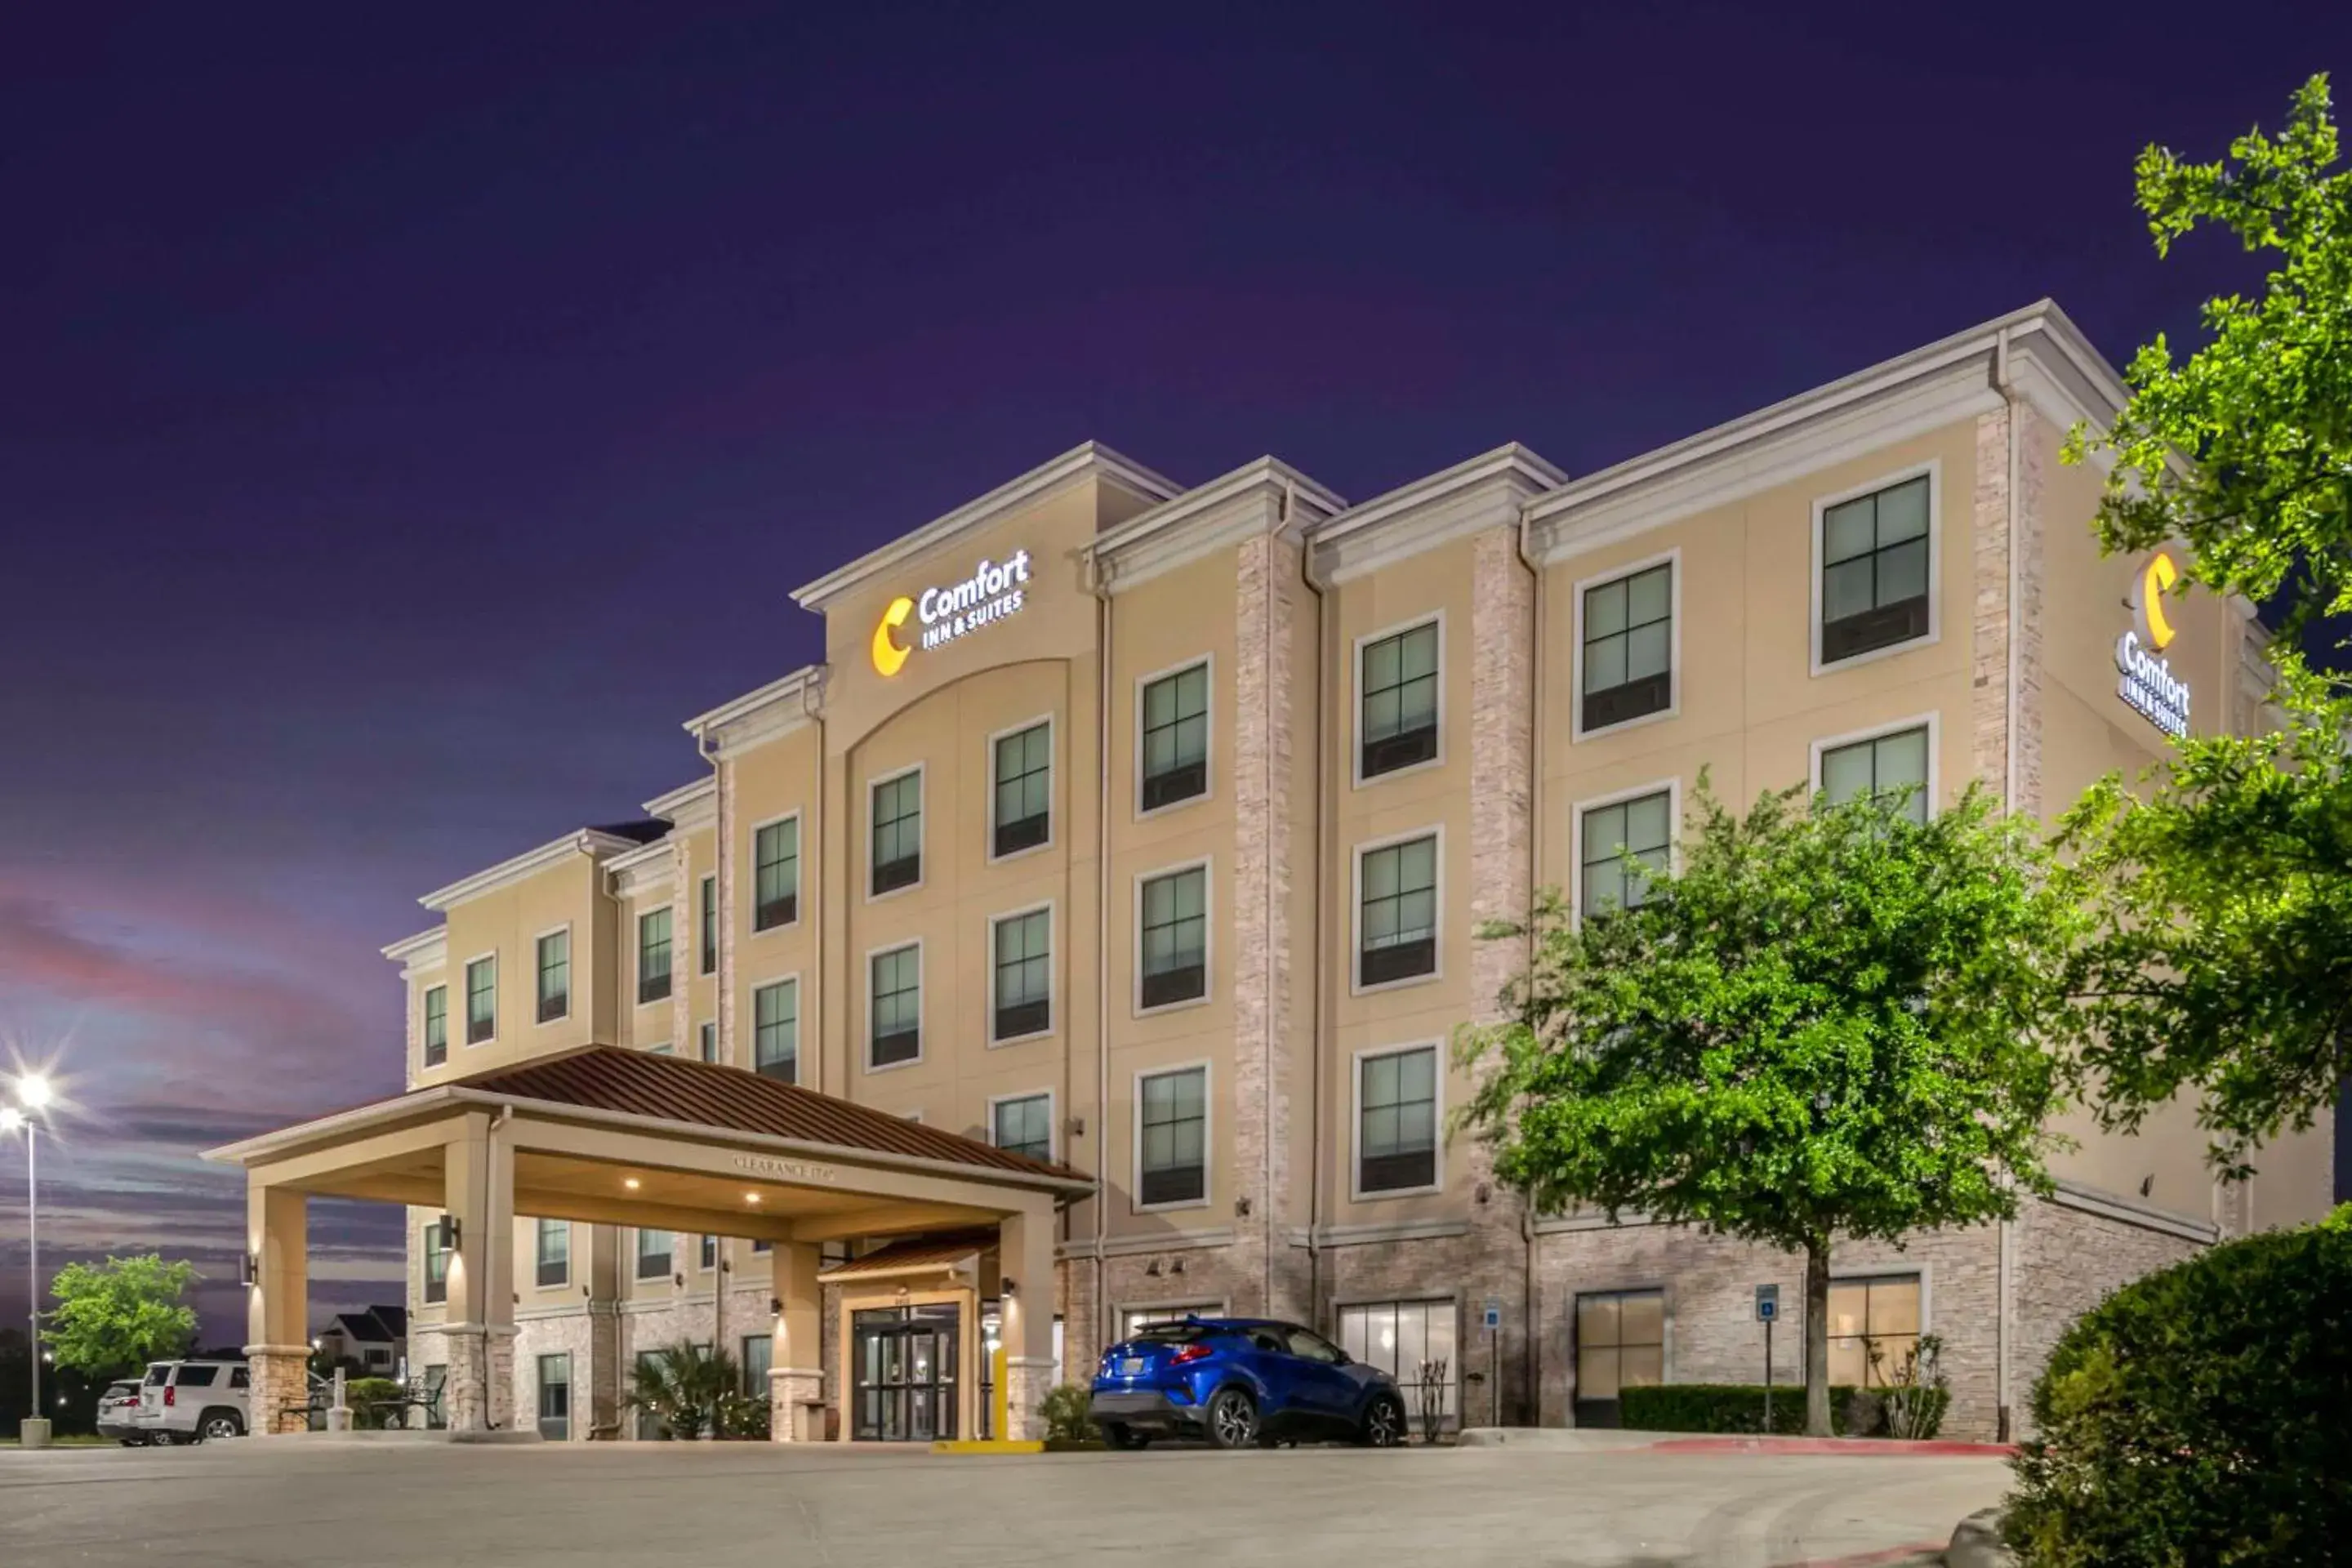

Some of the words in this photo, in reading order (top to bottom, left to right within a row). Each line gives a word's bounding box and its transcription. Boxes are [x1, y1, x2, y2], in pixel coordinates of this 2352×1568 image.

[920, 550, 1028, 624] Comfort
[923, 622, 951, 649] INN
[954, 617, 966, 635] &
[967, 590, 1022, 630] SUITES
[2124, 631, 2189, 715] Comfort
[733, 1156, 807, 1178] CLEARANCE
